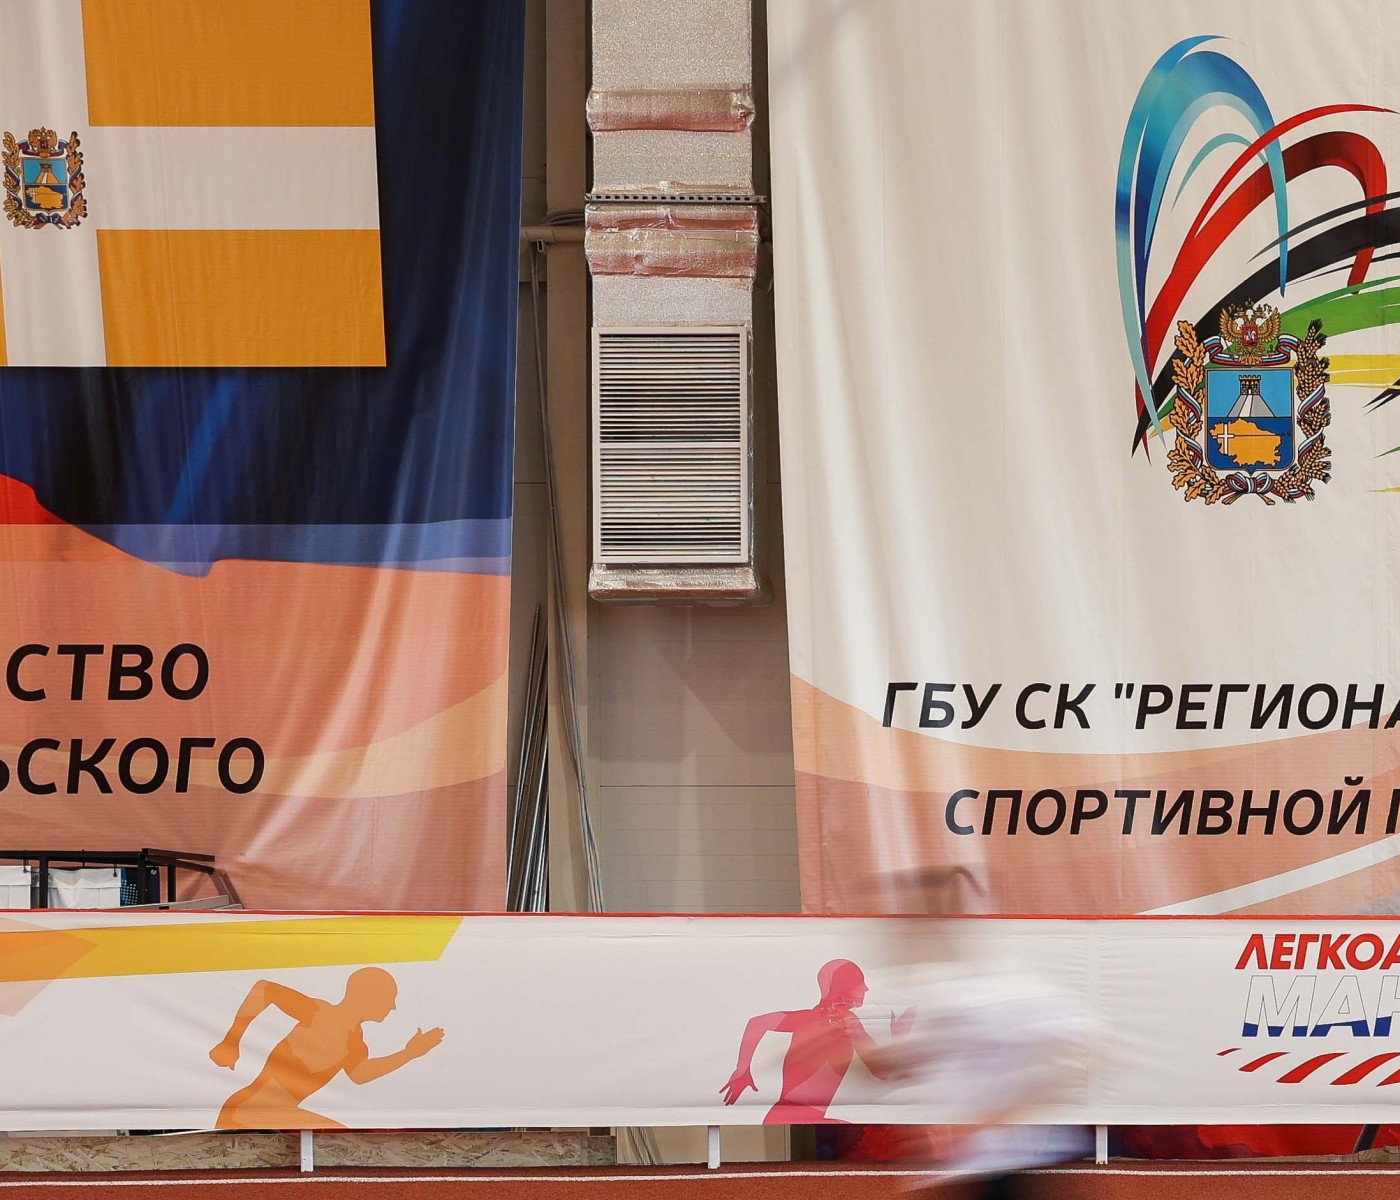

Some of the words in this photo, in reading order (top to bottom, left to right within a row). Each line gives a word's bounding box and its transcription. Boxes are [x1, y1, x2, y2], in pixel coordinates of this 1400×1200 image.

[5, 642, 210, 702] СТВО
[882, 682, 1004, 730] ГБУ
[1015, 682, 1098, 730] СК
[0, 737, 265, 796] СКОГО
[945, 776, 1373, 836] СПОРТИВНОЙ
